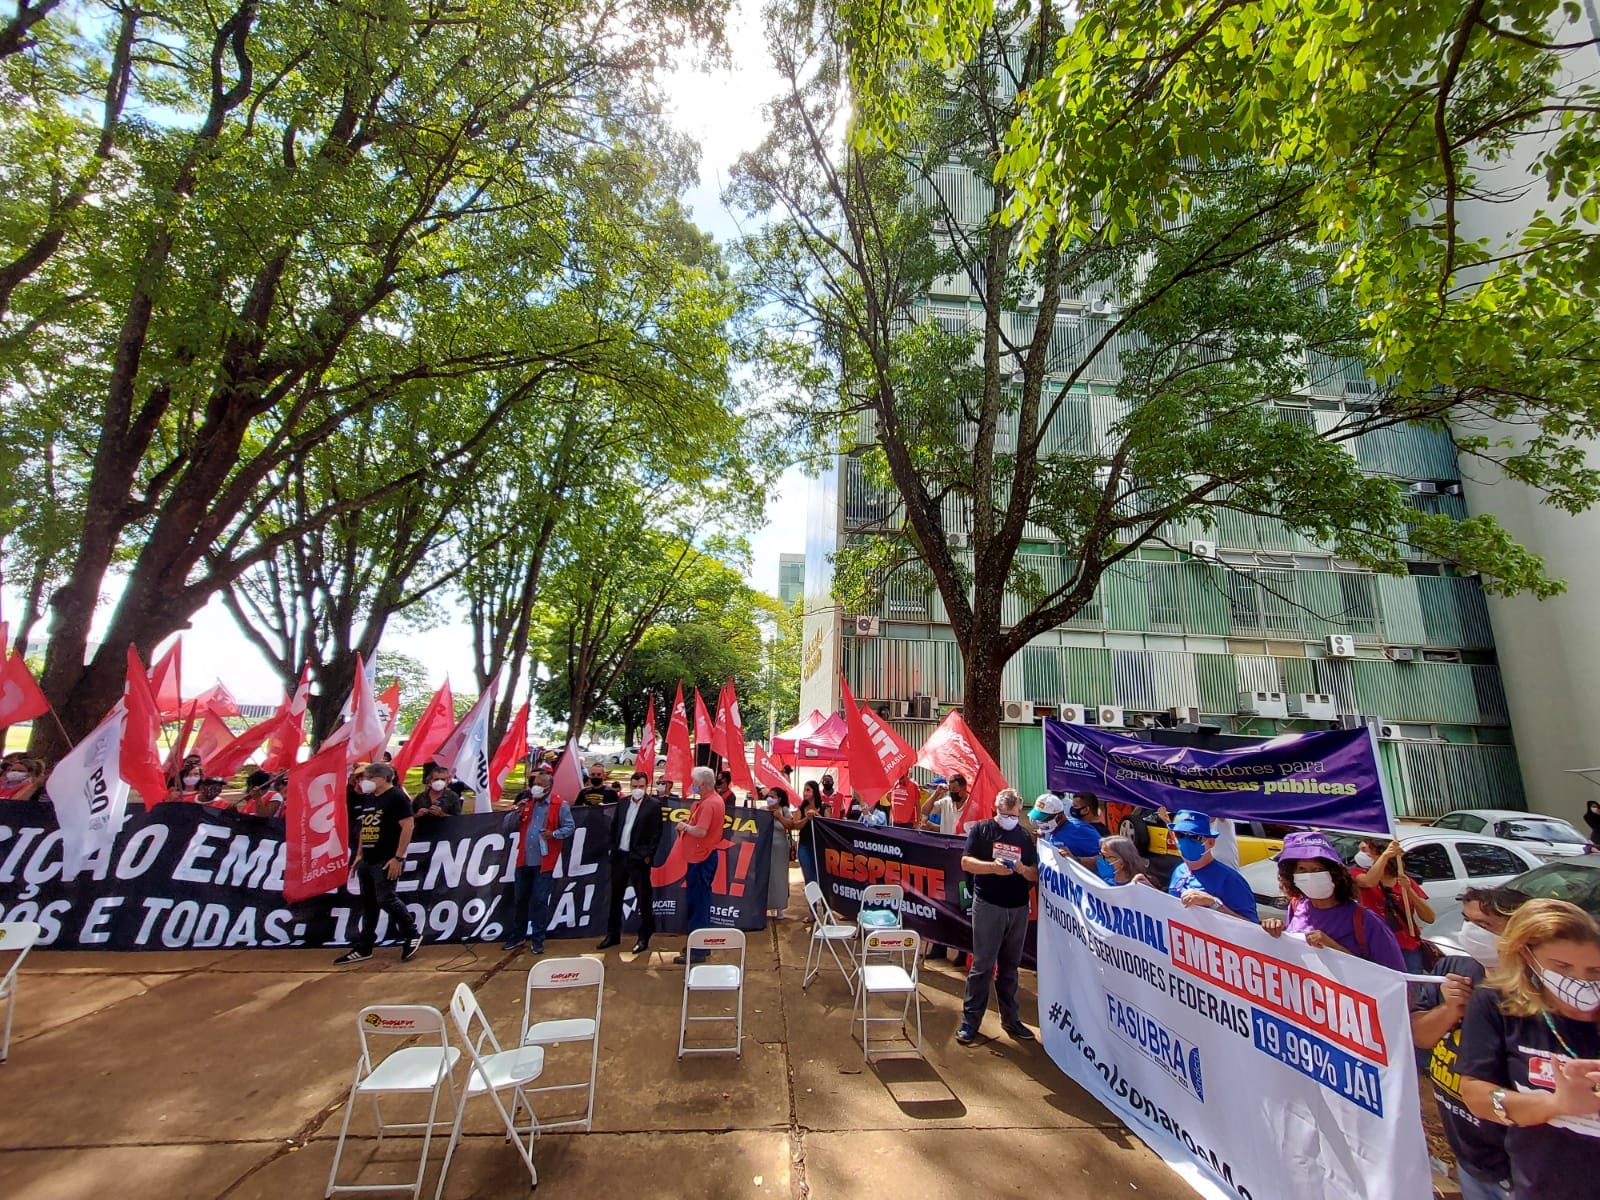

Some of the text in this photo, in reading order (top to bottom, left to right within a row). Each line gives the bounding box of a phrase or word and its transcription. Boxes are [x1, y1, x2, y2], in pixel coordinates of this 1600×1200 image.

[1064, 759, 1089, 770] ANESP
[1179, 763, 1275, 778] servidores
[1278, 760, 1327, 778] para
[1263, 778, 1358, 796] públicas
[853, 839, 904, 858] BOLSONARO,
[994, 842, 1020, 853] CSP
[825, 848, 946, 901] RESPEITE
[832, 883, 839, 894] O
[78, 896, 125, 944] E
[134, 896, 306, 948] TODAS:
[1085, 891, 1169, 955] SALARIAL
[1170, 926, 1383, 1054] EMERGENCIAL
[1094, 938, 1166, 993] SERVIDORES
[1169, 973, 1249, 1039] FEDERAIS
[1256, 1017, 1337, 1087] 19,99%
[1343, 1061, 1380, 1111] JÁ!
[1106, 992, 1188, 1079] FASUBRA
